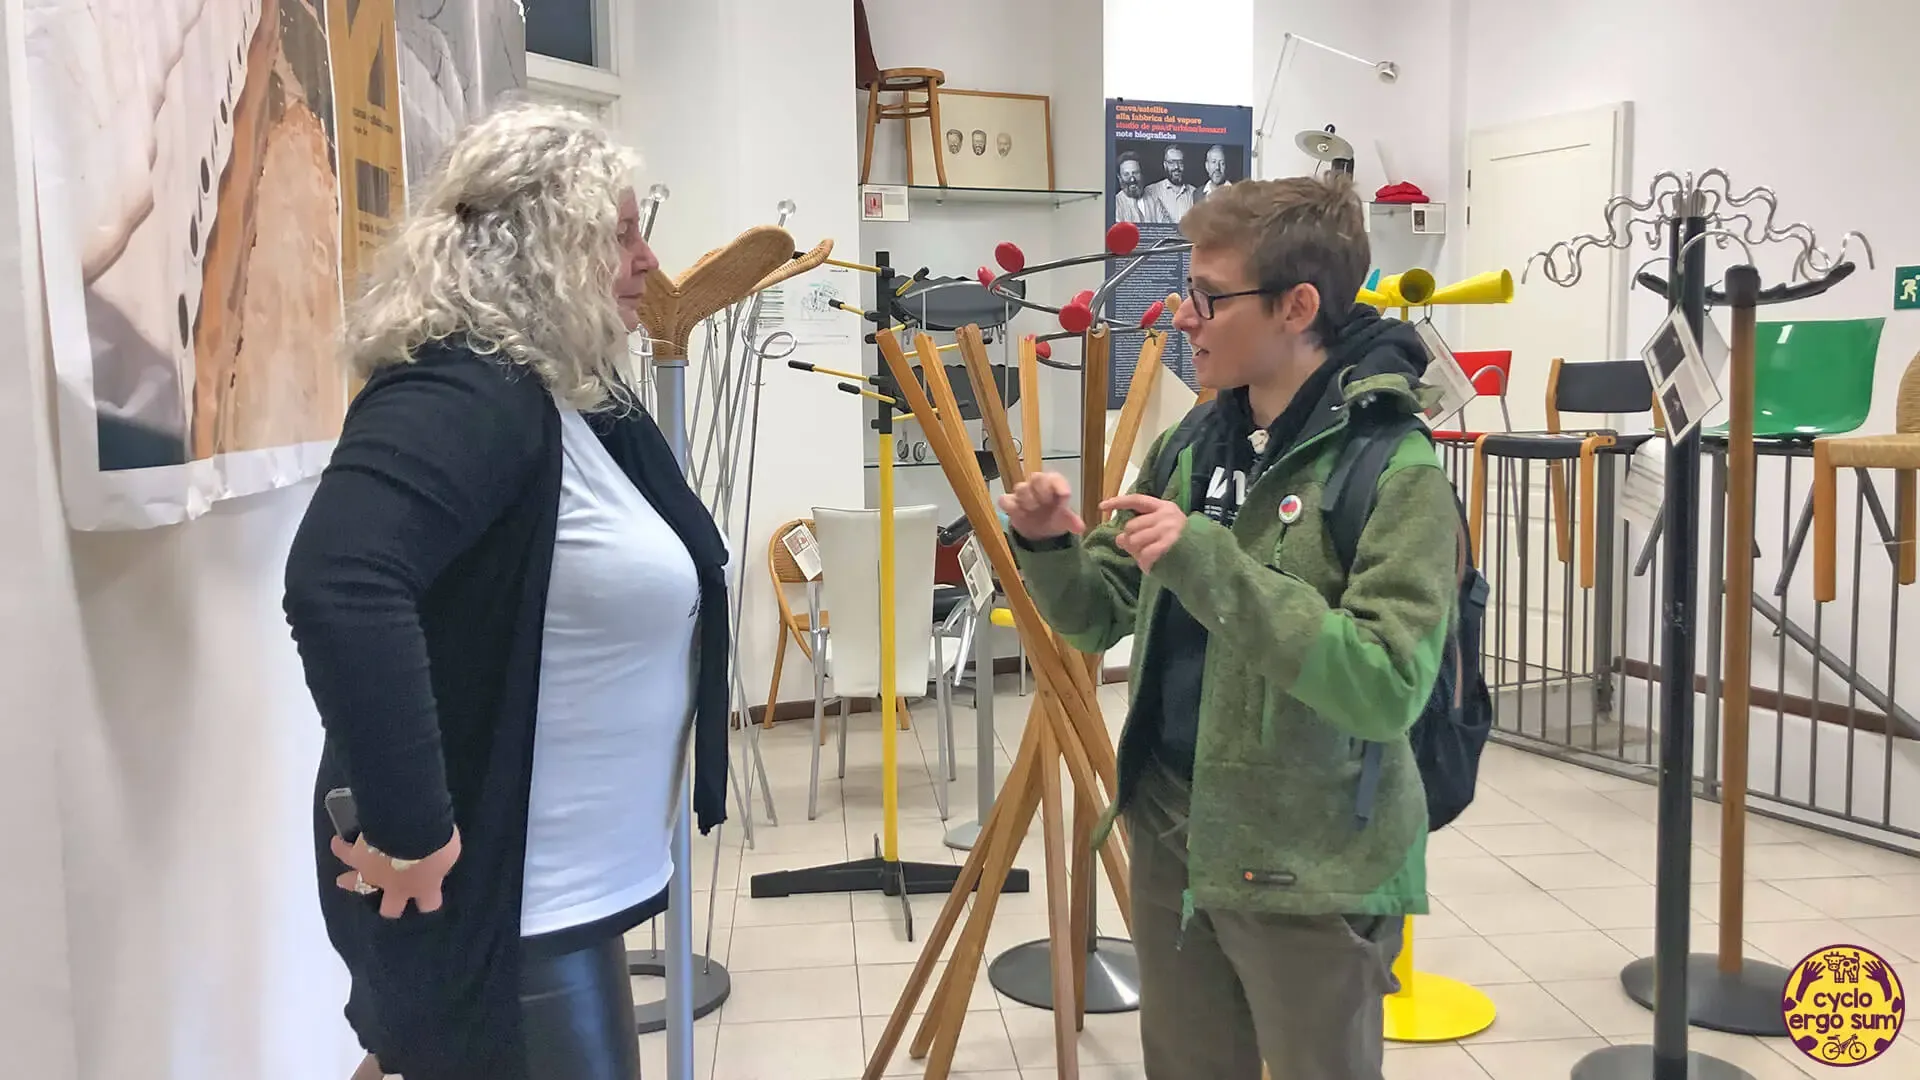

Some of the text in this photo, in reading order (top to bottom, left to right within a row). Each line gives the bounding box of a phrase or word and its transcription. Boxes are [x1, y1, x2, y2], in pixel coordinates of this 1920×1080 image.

[1115, 113, 1202, 125] alla fabbrica del vapore
[1115, 121, 1139, 129] studio
[1134, 131, 1177, 140] biografiche
